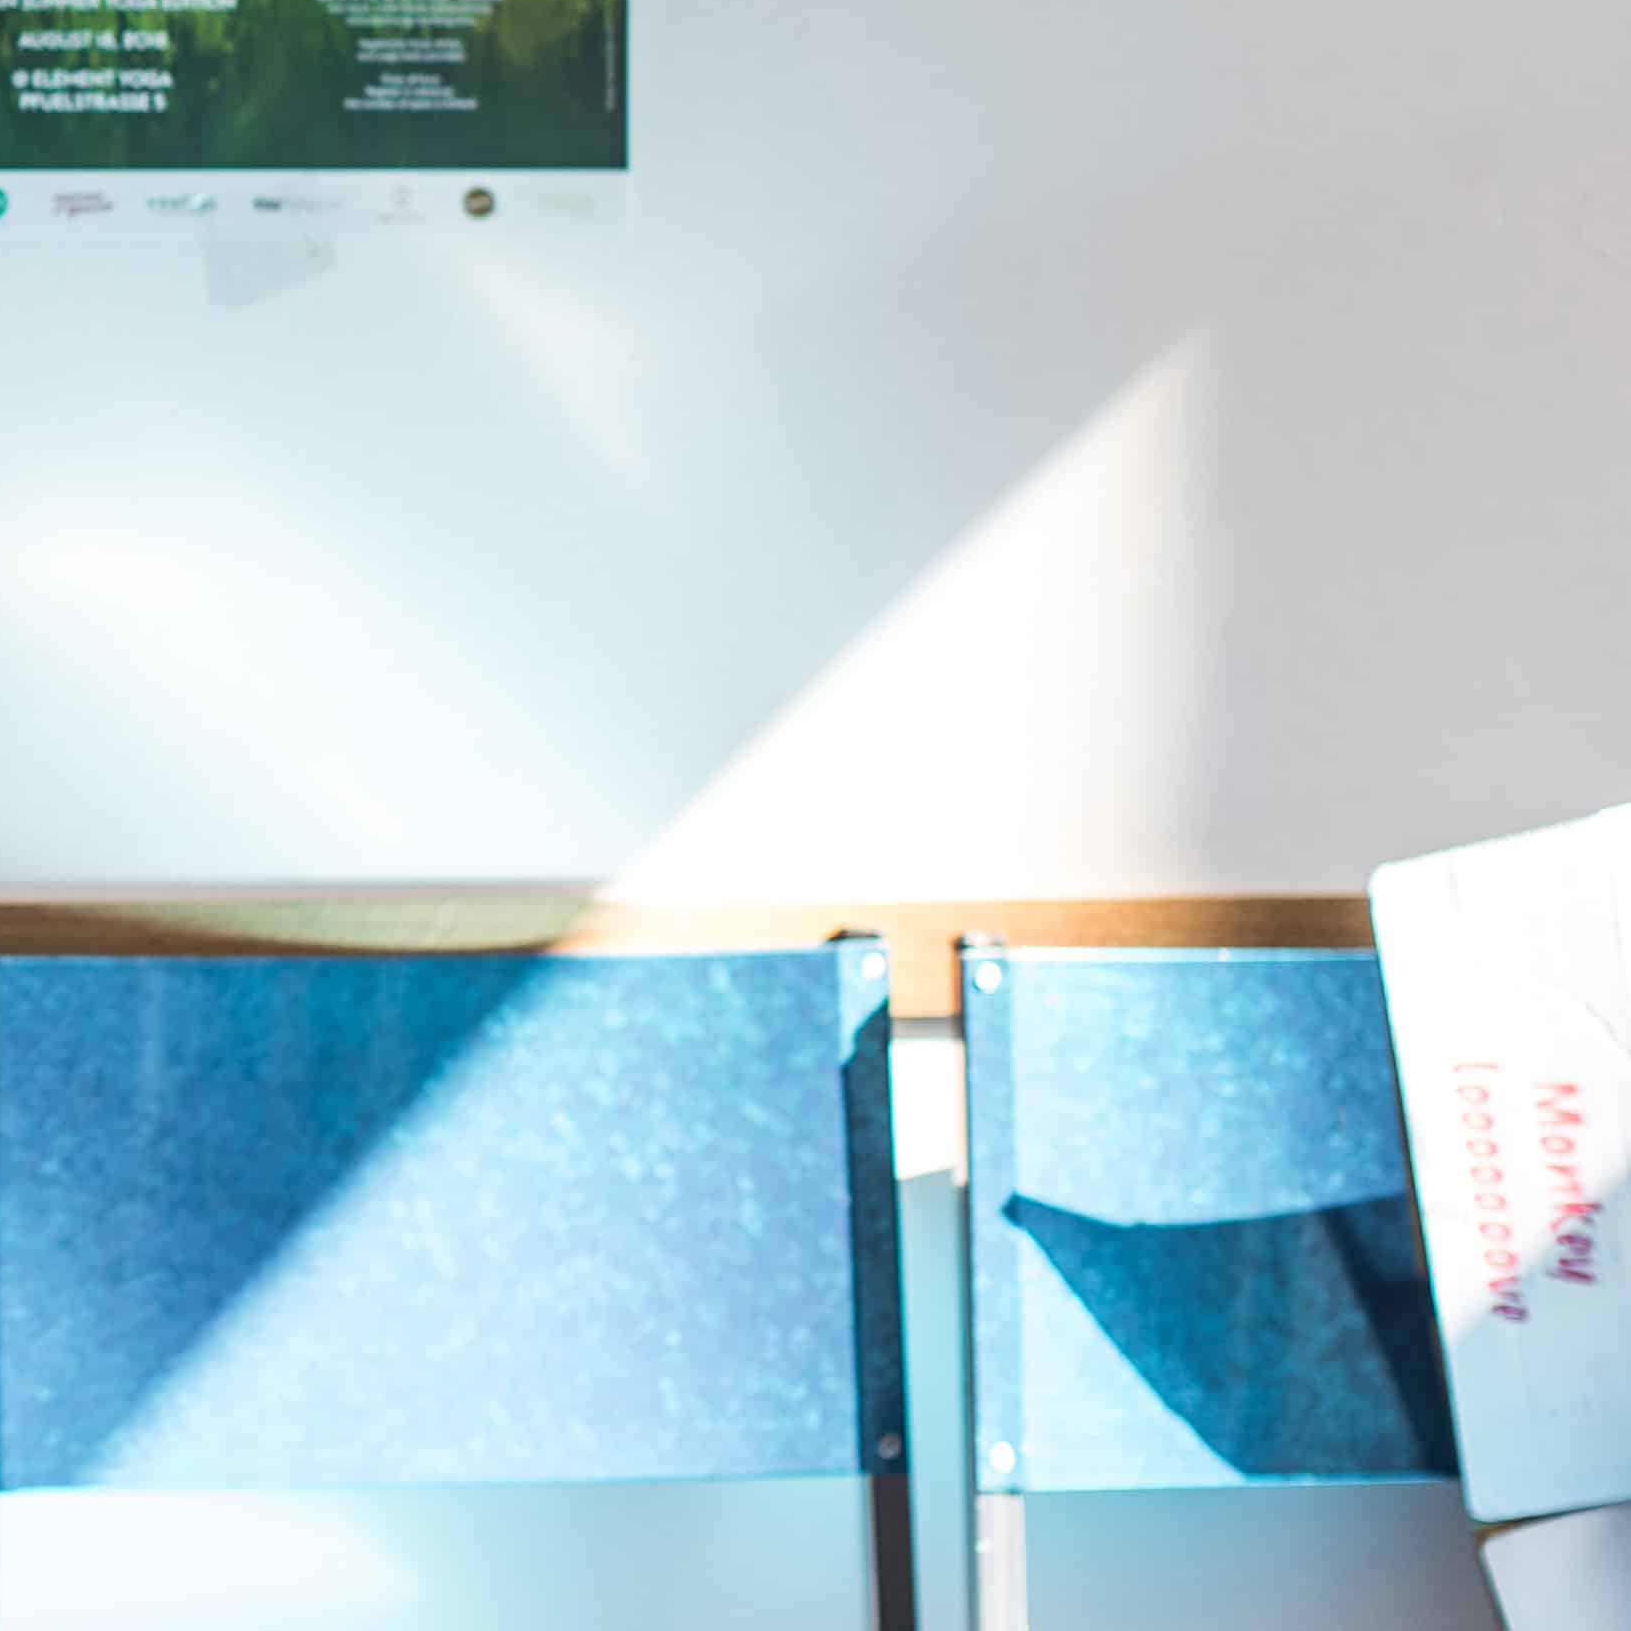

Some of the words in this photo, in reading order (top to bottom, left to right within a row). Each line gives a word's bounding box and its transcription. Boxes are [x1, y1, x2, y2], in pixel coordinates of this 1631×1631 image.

[17, 29, 92, 51] AUGUST
[31, 67, 116, 88] ELEMENT
[118, 67, 176, 88] YOGA
